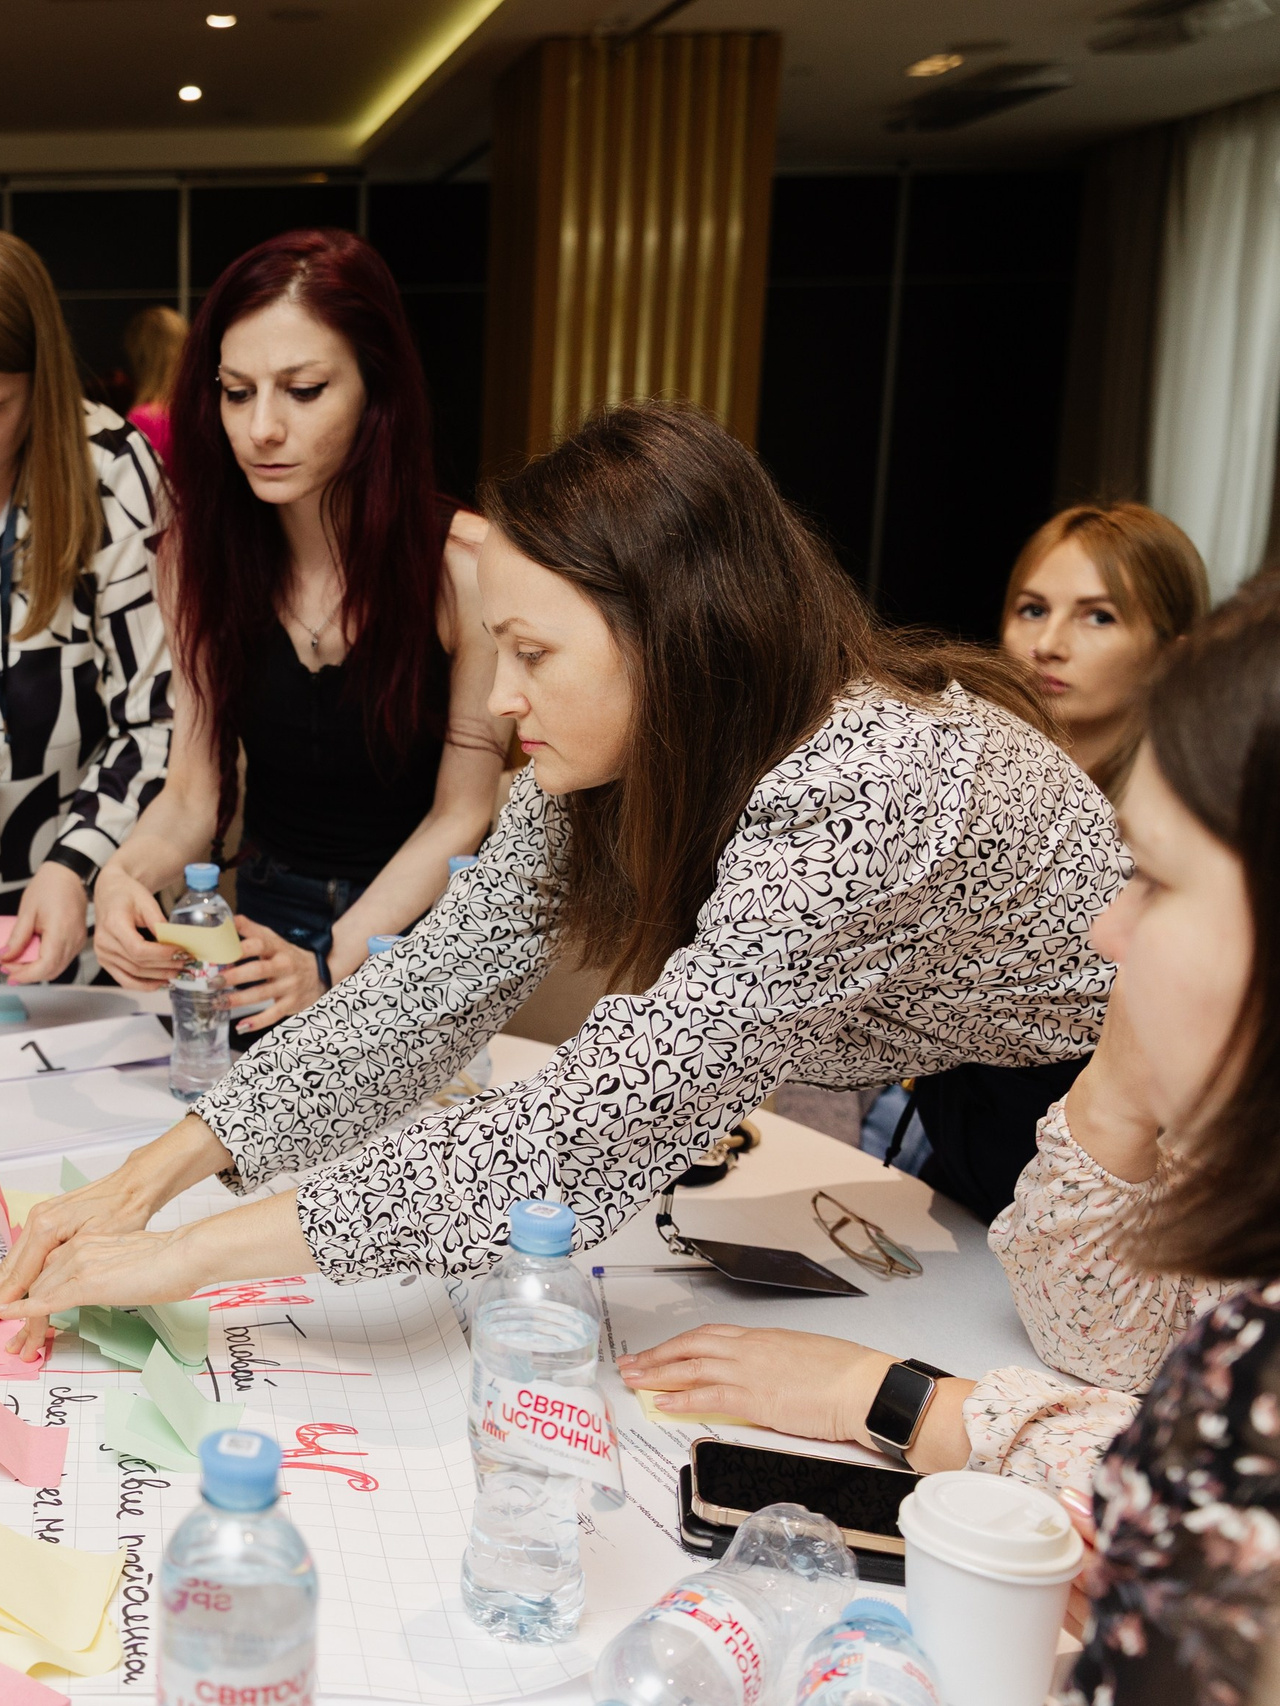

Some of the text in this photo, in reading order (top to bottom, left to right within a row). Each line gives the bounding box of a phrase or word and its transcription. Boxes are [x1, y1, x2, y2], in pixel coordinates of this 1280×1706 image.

[20, 1040, 66, 1073] 1
[502, 1403, 612, 1463] ИСТОЧНИК
[517, 1389, 602, 1435] СВЯТОЙ
